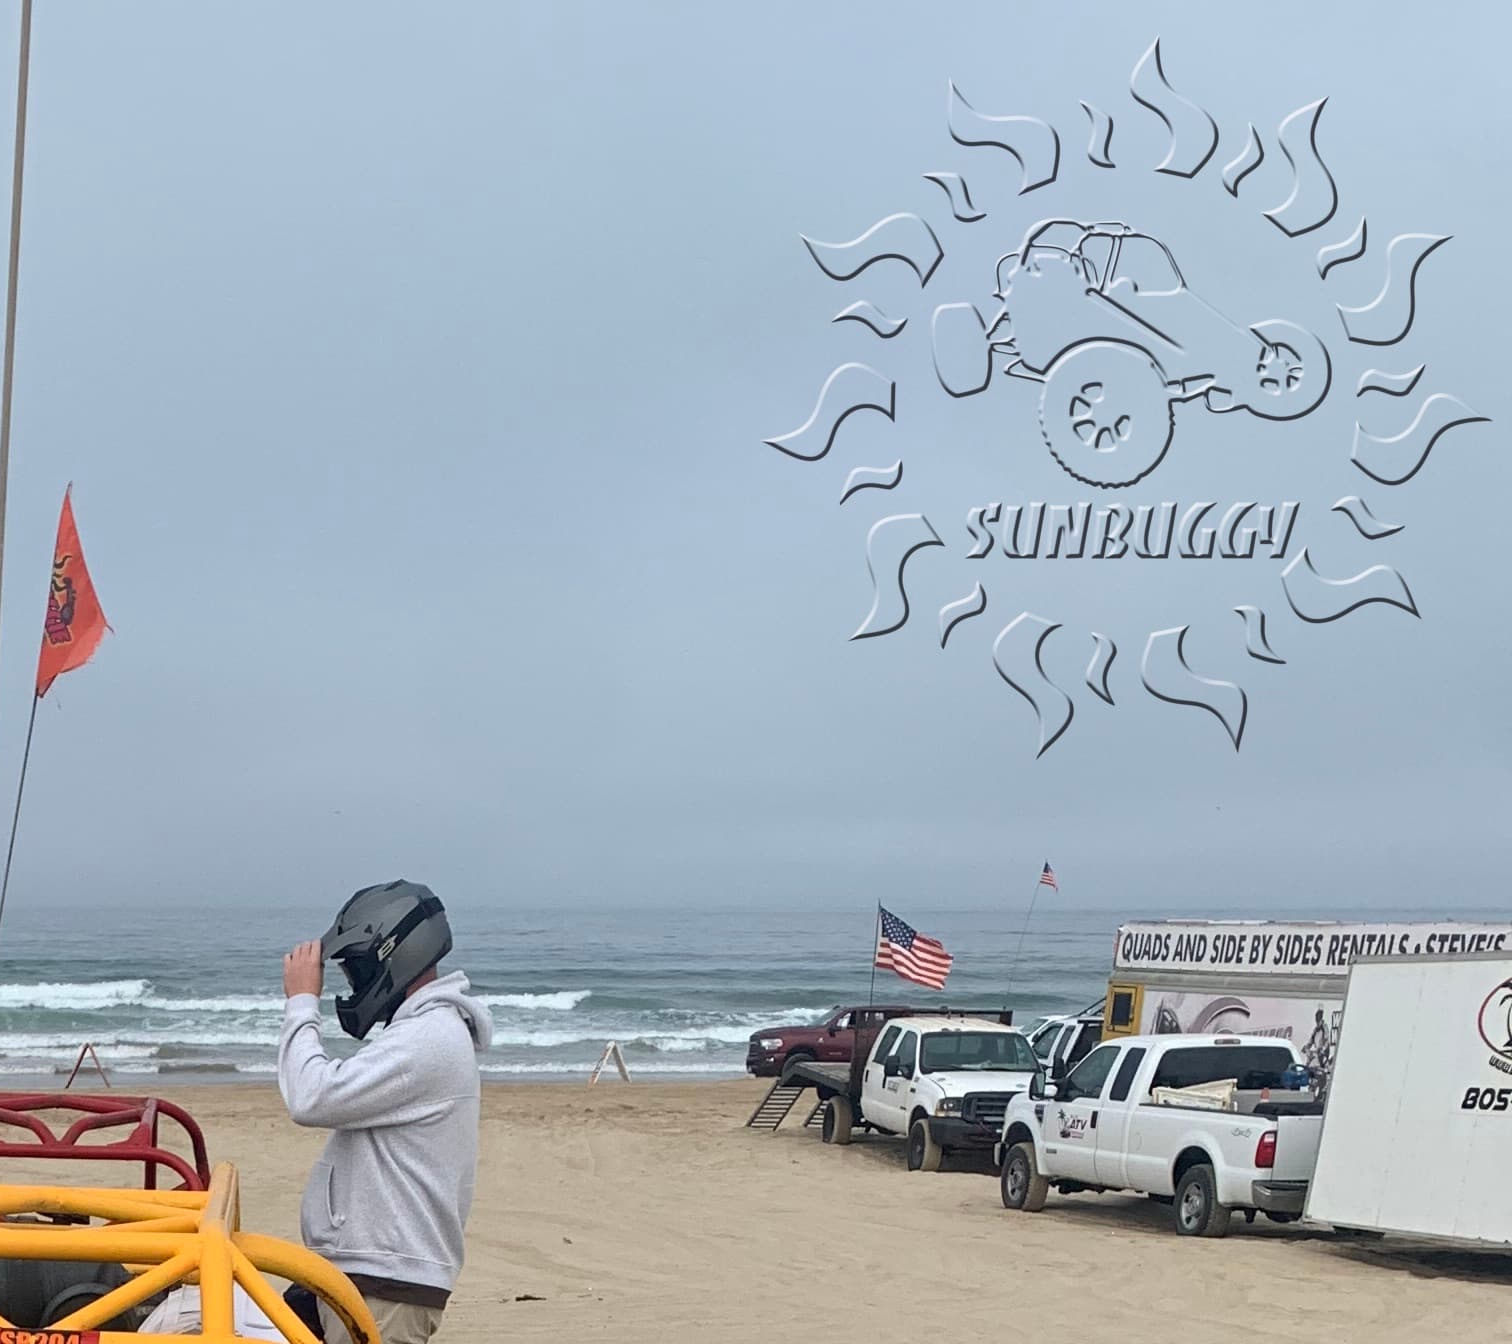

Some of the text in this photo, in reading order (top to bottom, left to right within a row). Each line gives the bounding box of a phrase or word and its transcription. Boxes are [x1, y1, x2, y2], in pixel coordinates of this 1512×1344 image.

[1122, 932, 1171, 962] QUADS
[1172, 933, 1207, 963] AND
[1209, 933, 1247, 964] SIDE
[1248, 934, 1273, 964] BY
[1273, 934, 1324, 966] SIDES
[1326, 933, 1410, 966] RENTALS
[1461, 1087, 1512, 1111] BOS
[1069, 1119, 1088, 1131] ATV
